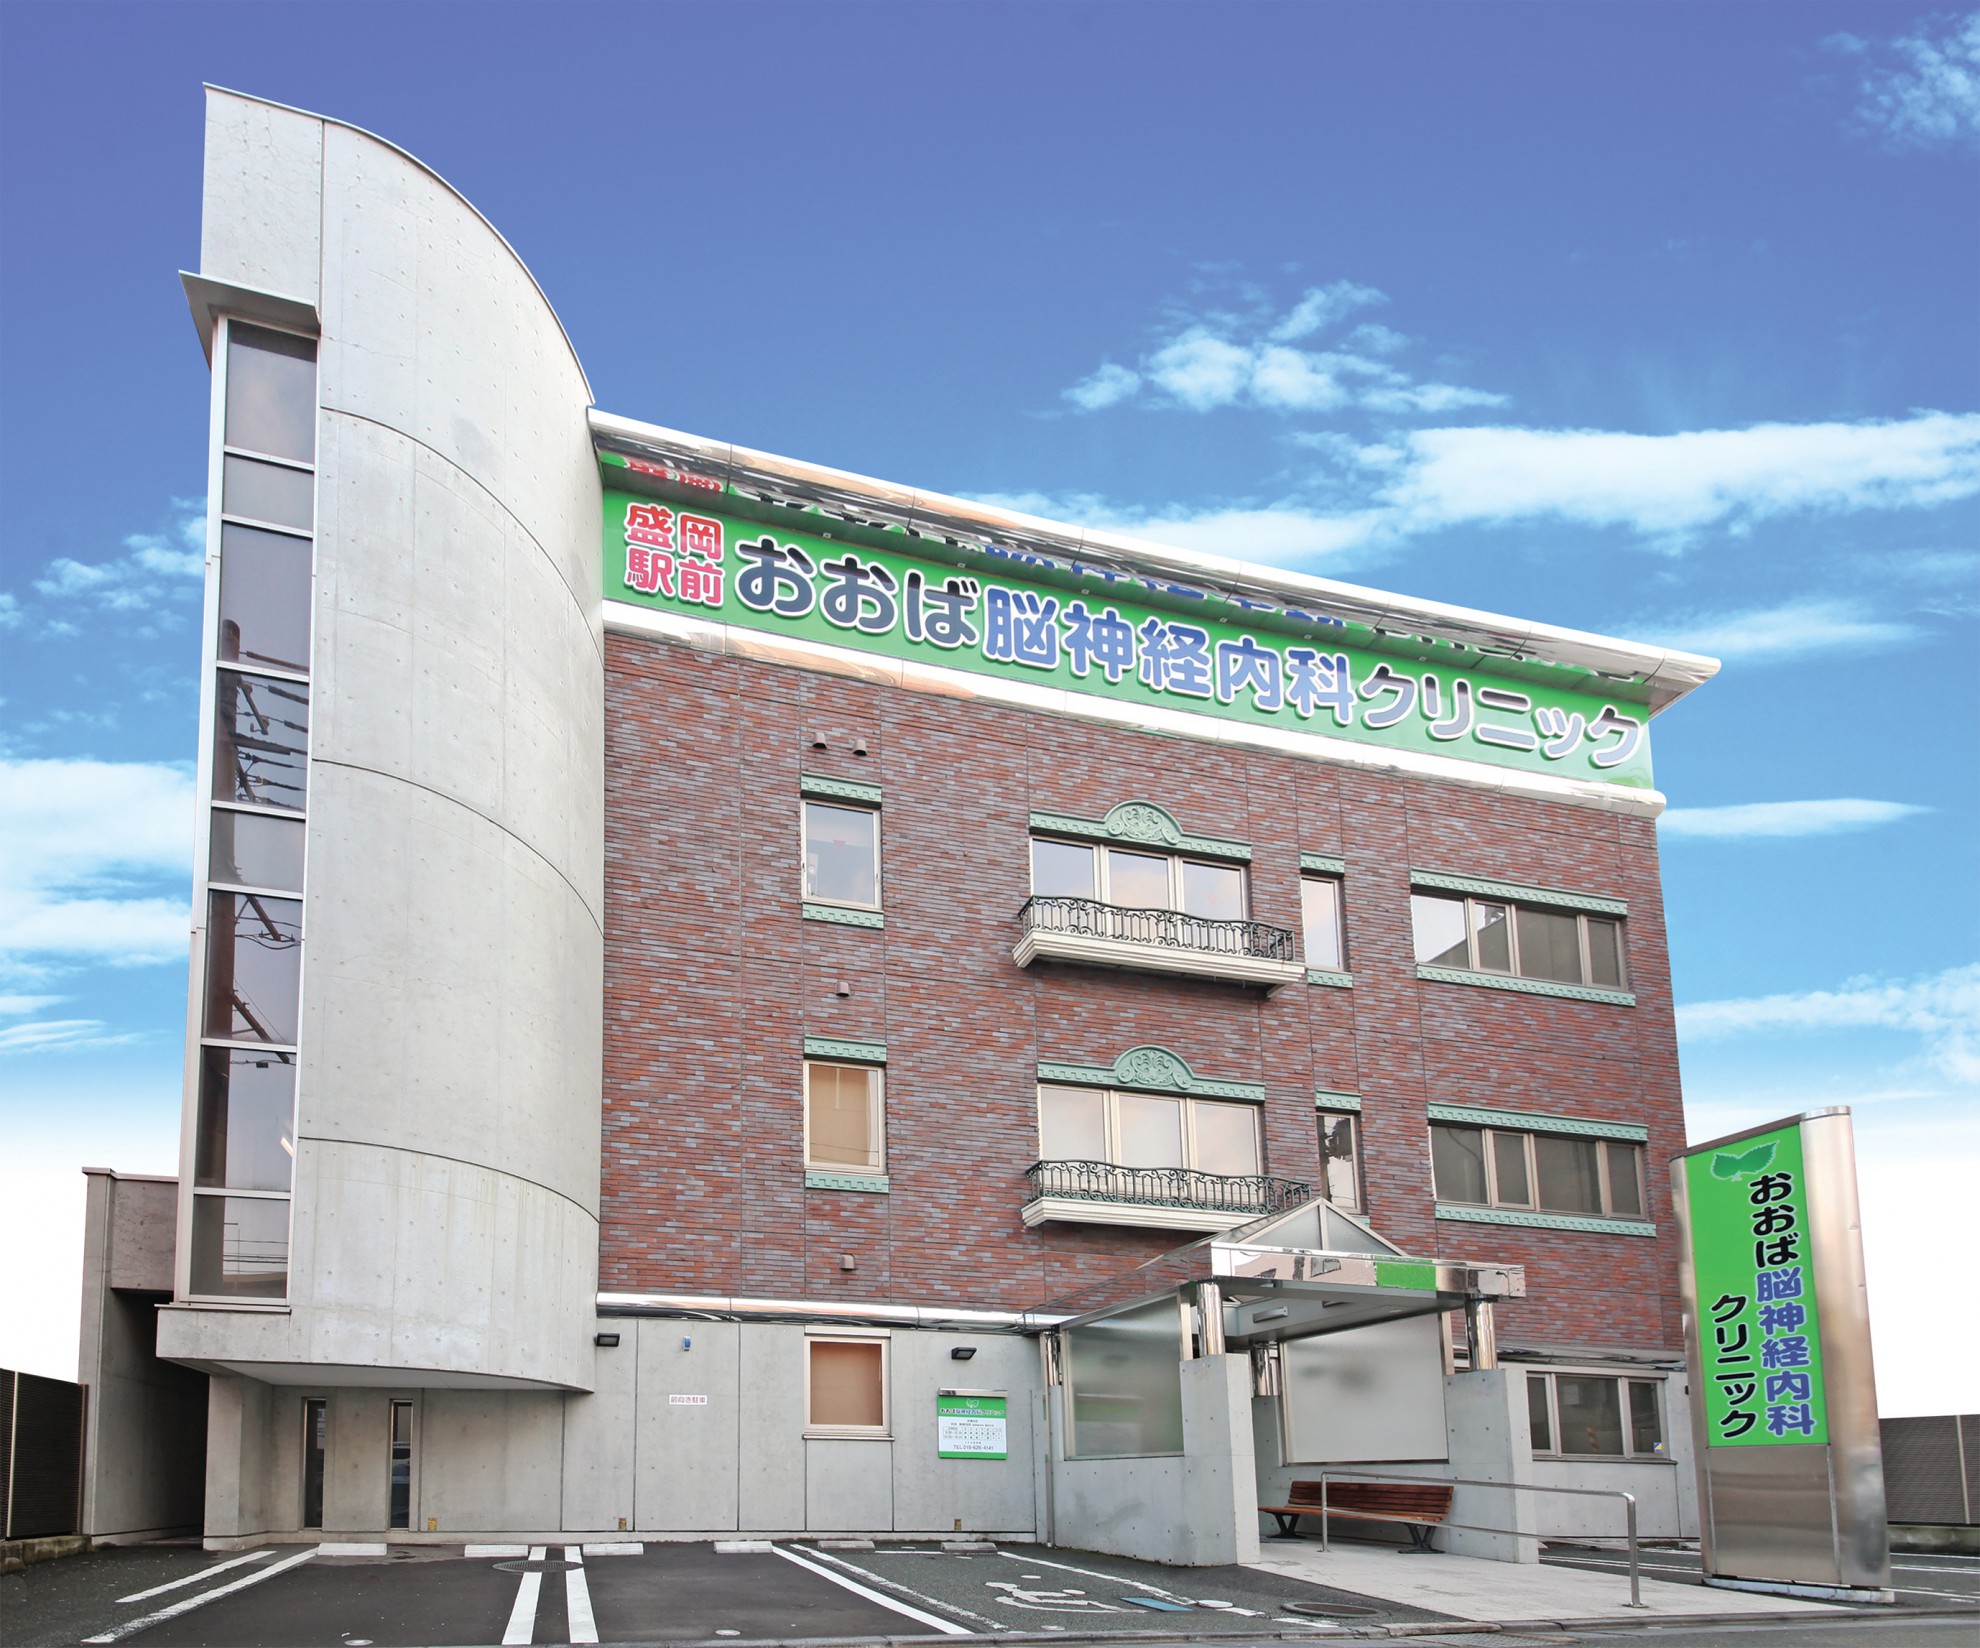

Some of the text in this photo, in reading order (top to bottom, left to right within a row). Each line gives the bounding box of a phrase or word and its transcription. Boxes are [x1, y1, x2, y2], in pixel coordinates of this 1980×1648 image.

[625, 548, 723, 606] 駅前
[626, 503, 723, 558] 盛岡
[736, 537, 1642, 768] おおば脳神経内科クリニック
[1710, 1294, 1757, 1438] クリニック
[1749, 1171, 1817, 1437] おおば脳神経内科
